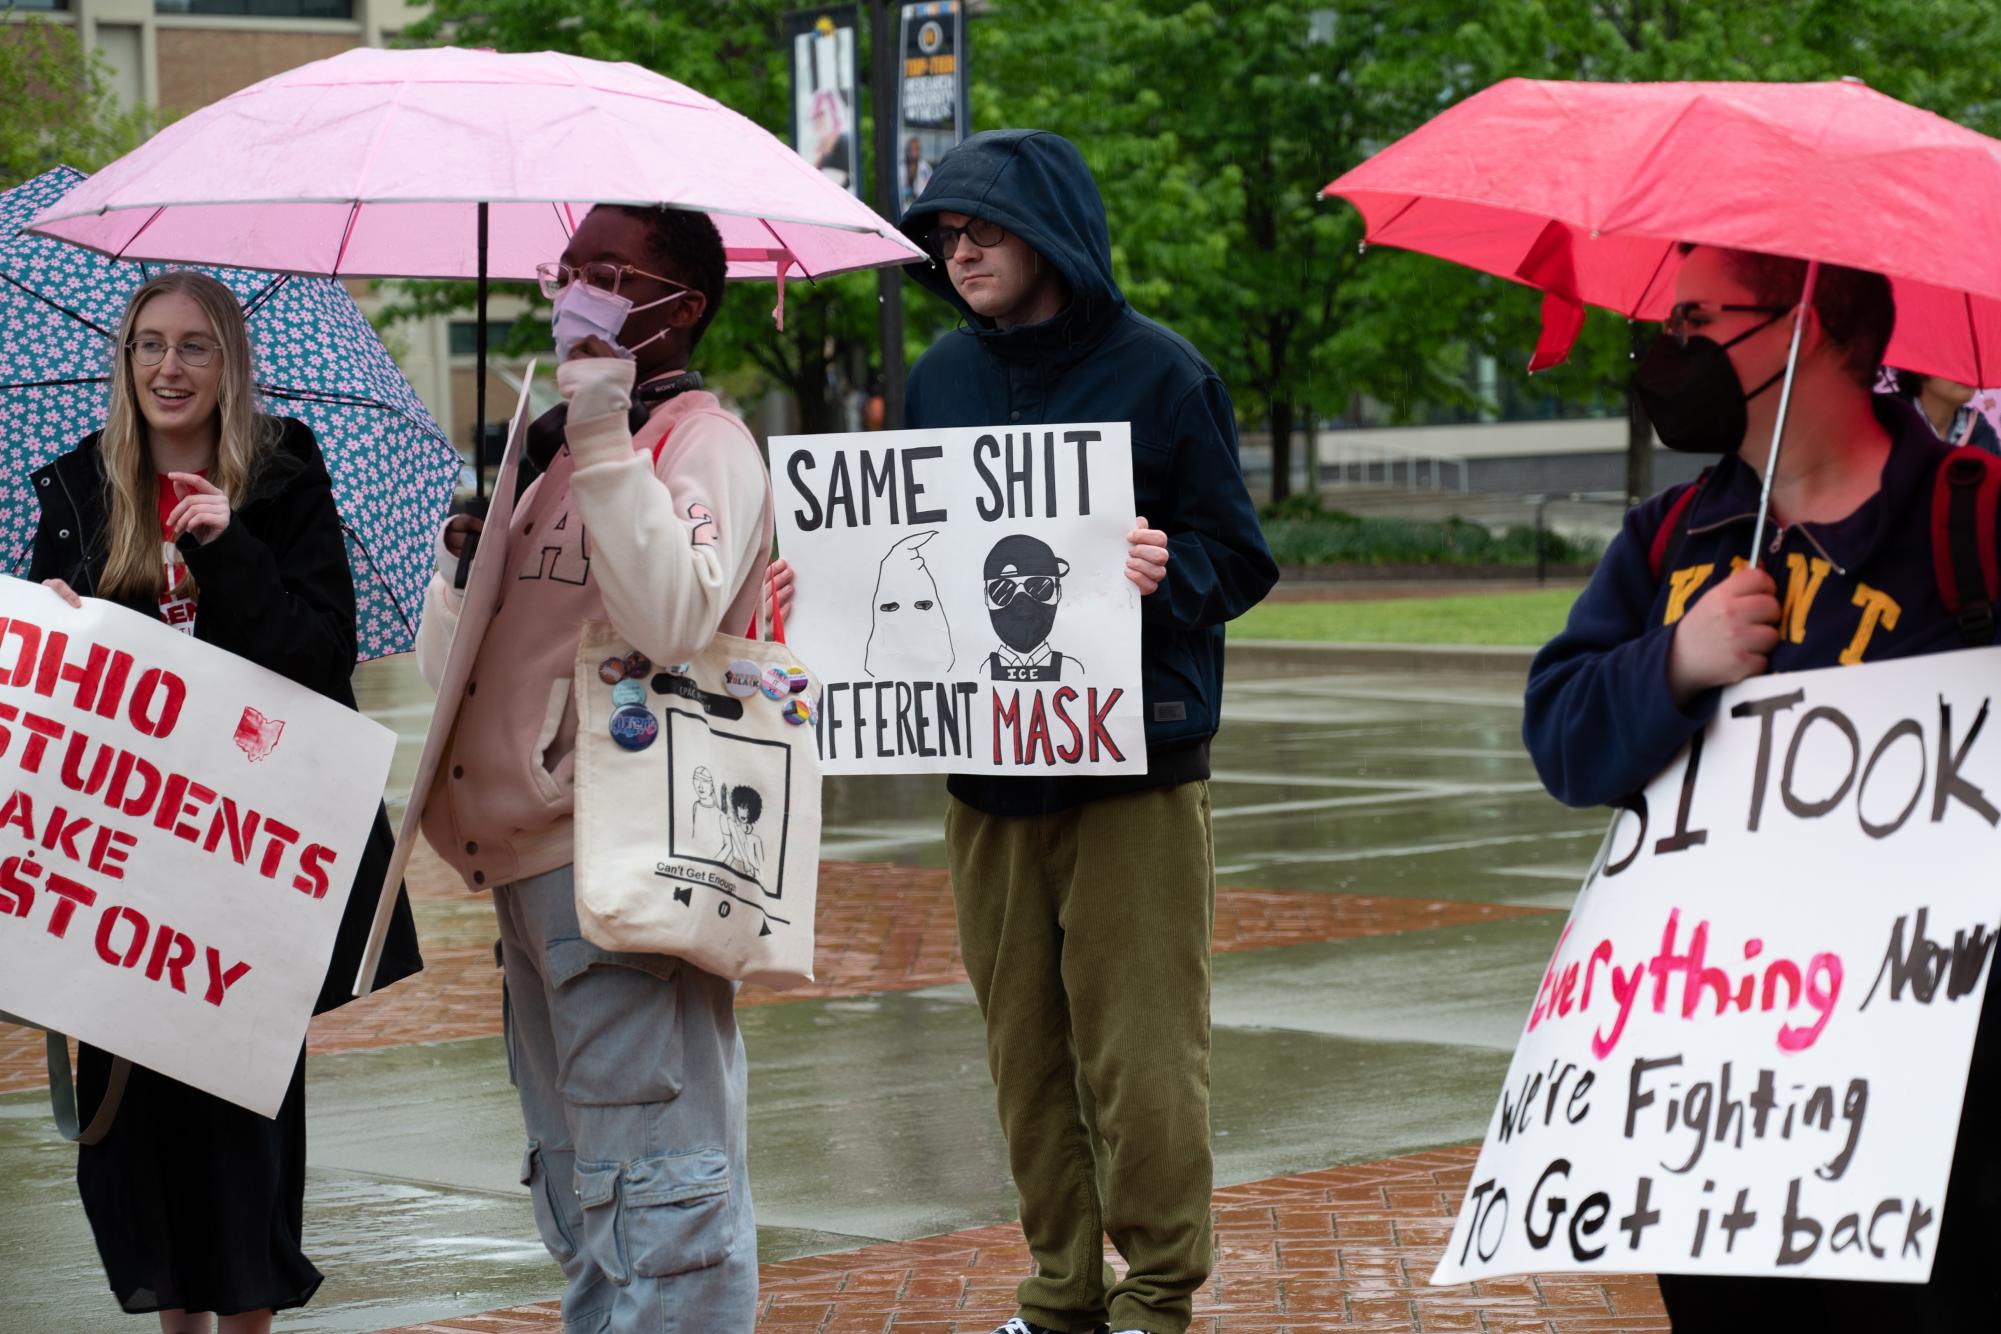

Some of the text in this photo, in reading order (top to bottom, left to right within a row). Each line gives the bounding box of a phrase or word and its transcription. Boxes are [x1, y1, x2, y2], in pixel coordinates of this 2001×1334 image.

[787, 431, 1101, 531] SAME SHIT
[1664, 553, 1901, 666] KNT
[816, 681, 1126, 766] IFFERENT MASK
[1007, 668, 1038, 680] ICE
[1732, 688, 2001, 839] TOOK
[0, 789, 138, 880] AKE
[657, 862, 684, 876] Can't
[686, 868, 706, 881] Get
[0, 856, 252, 1007] STORY
[1624, 1055, 1869, 1180] Fighting
[1524, 1159, 1660, 1261] Get
[1690, 1179, 1757, 1258] it
[1776, 1178, 1933, 1266] back
